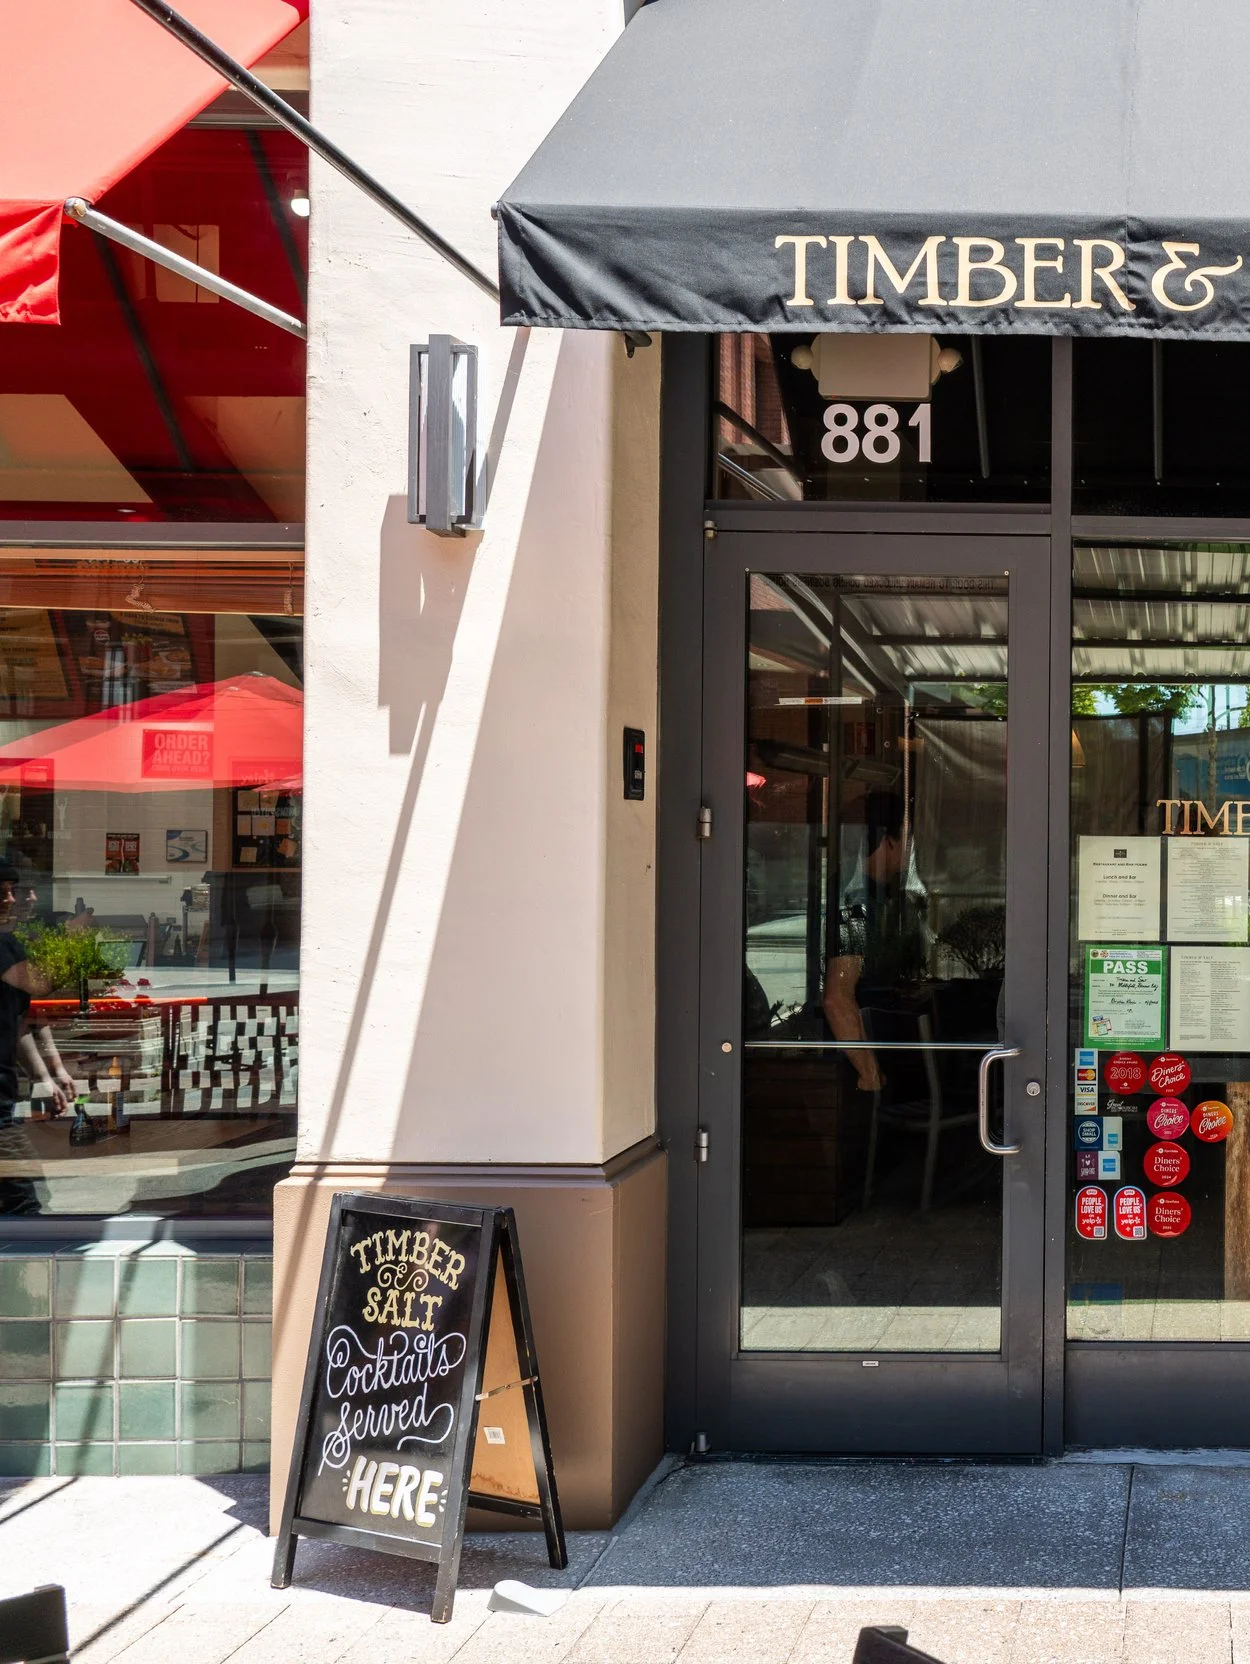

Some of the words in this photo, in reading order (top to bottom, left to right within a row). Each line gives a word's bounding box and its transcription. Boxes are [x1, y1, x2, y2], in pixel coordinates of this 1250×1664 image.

[775, 235, 1137, 311] TIMBER
[1151, 241, 1243, 312] &
[820, 403, 933, 463] 881
[154, 732, 209, 751] ORDER
[152, 750, 211, 766] AHEAD?
[1103, 960, 1148, 974] PASS
[1110, 1066, 1142, 1080] 2018
[1151, 1060, 1186, 1083] Diners'
[1158, 1072, 1186, 1088] Choice
[1153, 1113, 1184, 1129] Choice
[1198, 1115, 1227, 1134] Choice
[1153, 1164, 1180, 1173] Choice
[1154, 1157, 1182, 1165] Diners'
[1081, 1197, 1102, 1205] PEOPLE
[1119, 1197, 1140, 1206] PEOPLE
[1081, 1205, 1094, 1214] LOVE
[1095, 1205, 1103, 1214] US
[1119, 1205, 1132, 1214] LOVE
[1133, 1205, 1141, 1214] US
[1155, 1206, 1184, 1215] Diners'
[1082, 1217, 1096, 1225] yelp
[1121, 1217, 1134, 1226] yelp
[1154, 1214, 1181, 1223] Choice
[350, 1228, 467, 1291] TIMBER
[377, 1261, 429, 1292] &
[362, 1286, 443, 1332] SALT
[326, 1324, 468, 1400] Cocktails
[317, 1382, 455, 1477] Served
[346, 1454, 444, 1528] HERE
